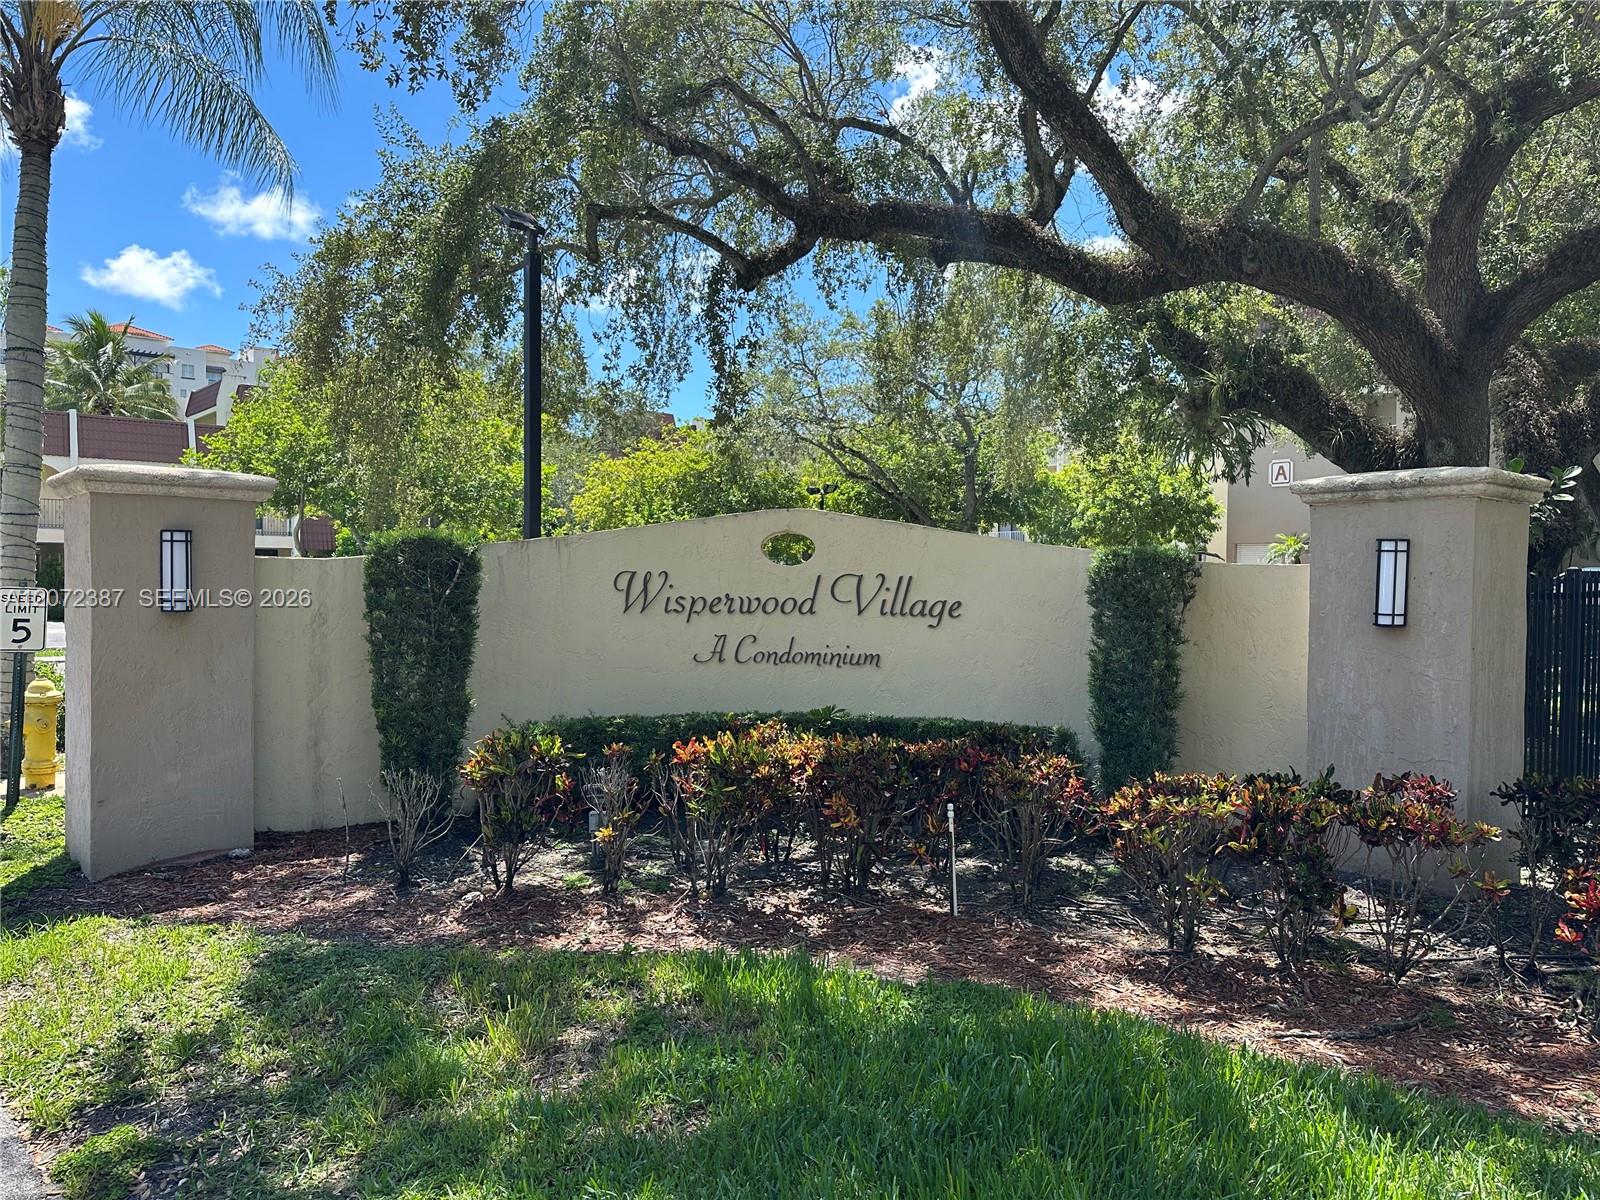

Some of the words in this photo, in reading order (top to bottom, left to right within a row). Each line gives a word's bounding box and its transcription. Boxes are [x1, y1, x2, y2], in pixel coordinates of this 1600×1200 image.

[1275, 465, 1288, 481] A
[1, 594, 42, 603] SPEED
[613, 570, 822, 623] Wisperwood
[830, 573, 963, 628] Village
[5, 605, 39, 614] LIMIT
[11, 618, 32, 644] 5
[693, 634, 727, 664] A
[734, 634, 881, 668] Condominium
